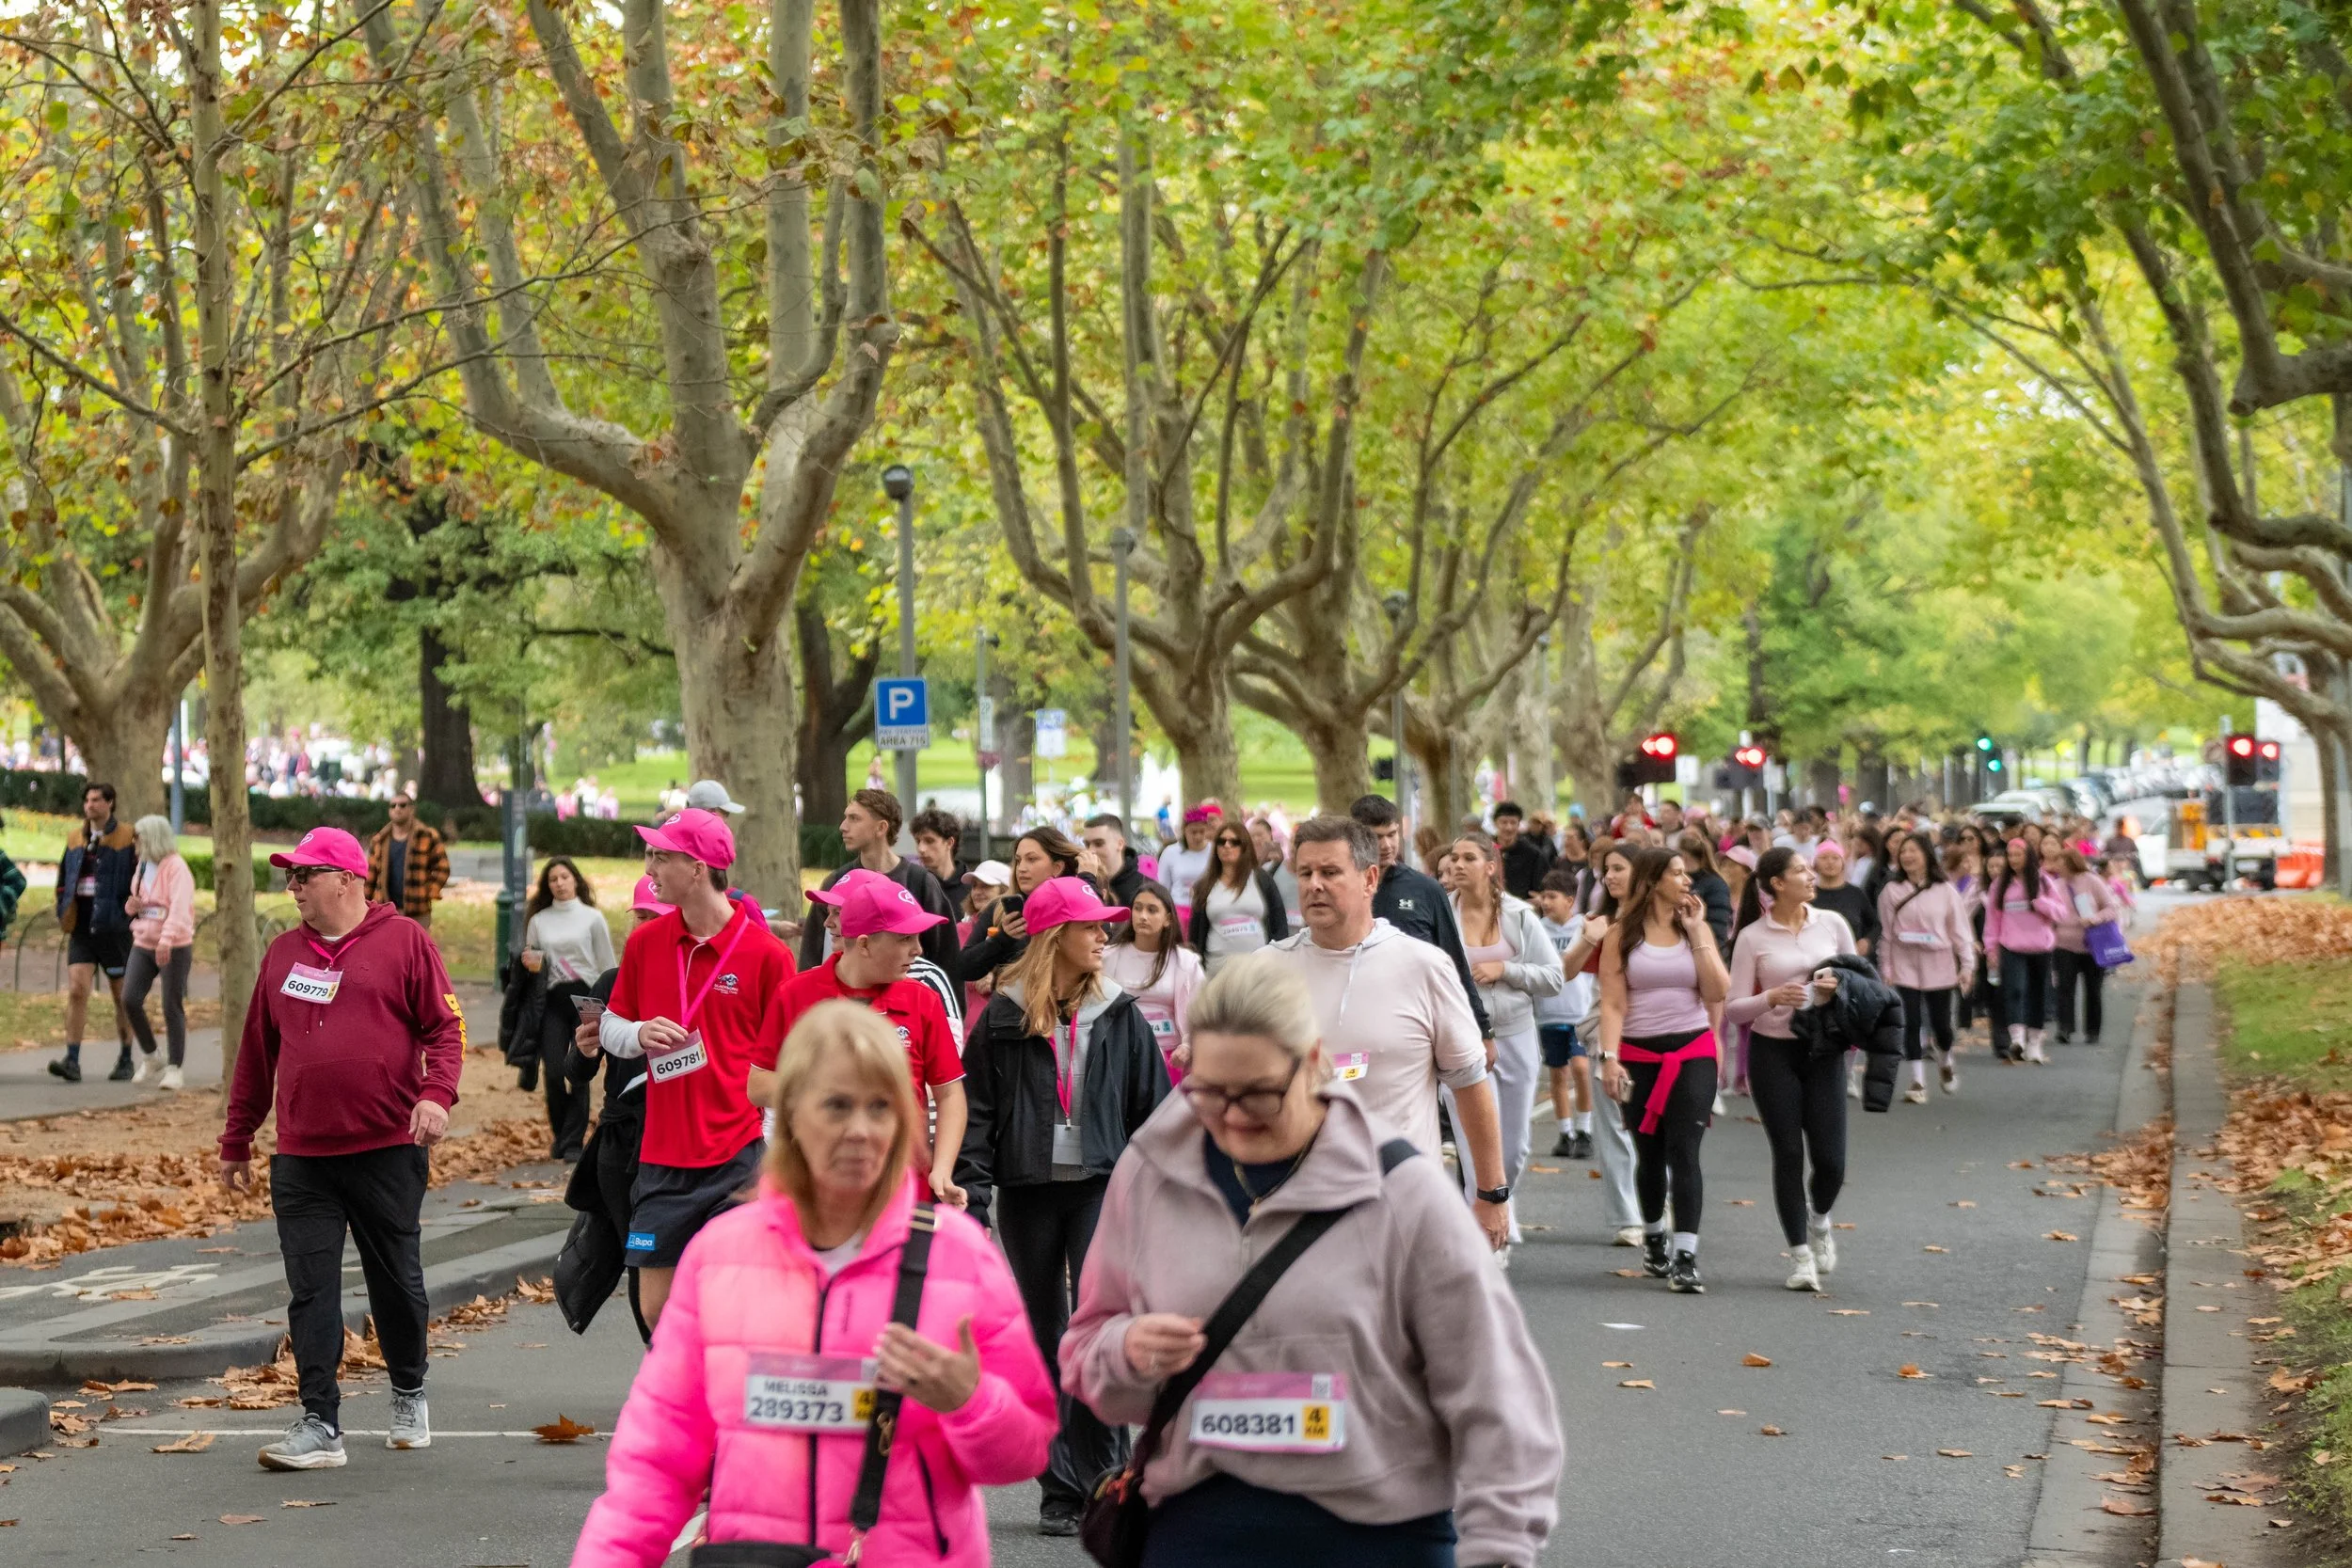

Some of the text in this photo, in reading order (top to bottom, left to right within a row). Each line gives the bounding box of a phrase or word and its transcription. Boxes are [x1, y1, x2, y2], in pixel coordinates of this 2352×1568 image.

[889, 688, 914, 721] P
[881, 736, 906, 746] AREA
[288, 980, 328, 997] 609779
[656, 1051, 700, 1074] 609781
[635, 1237, 653, 1246] Bupa
[763, 1380, 828, 1396] MELISSA
[751, 1396, 843, 1423] 289373
[1308, 1408, 1322, 1424] 4
[1200, 1414, 1295, 1434] 608381
